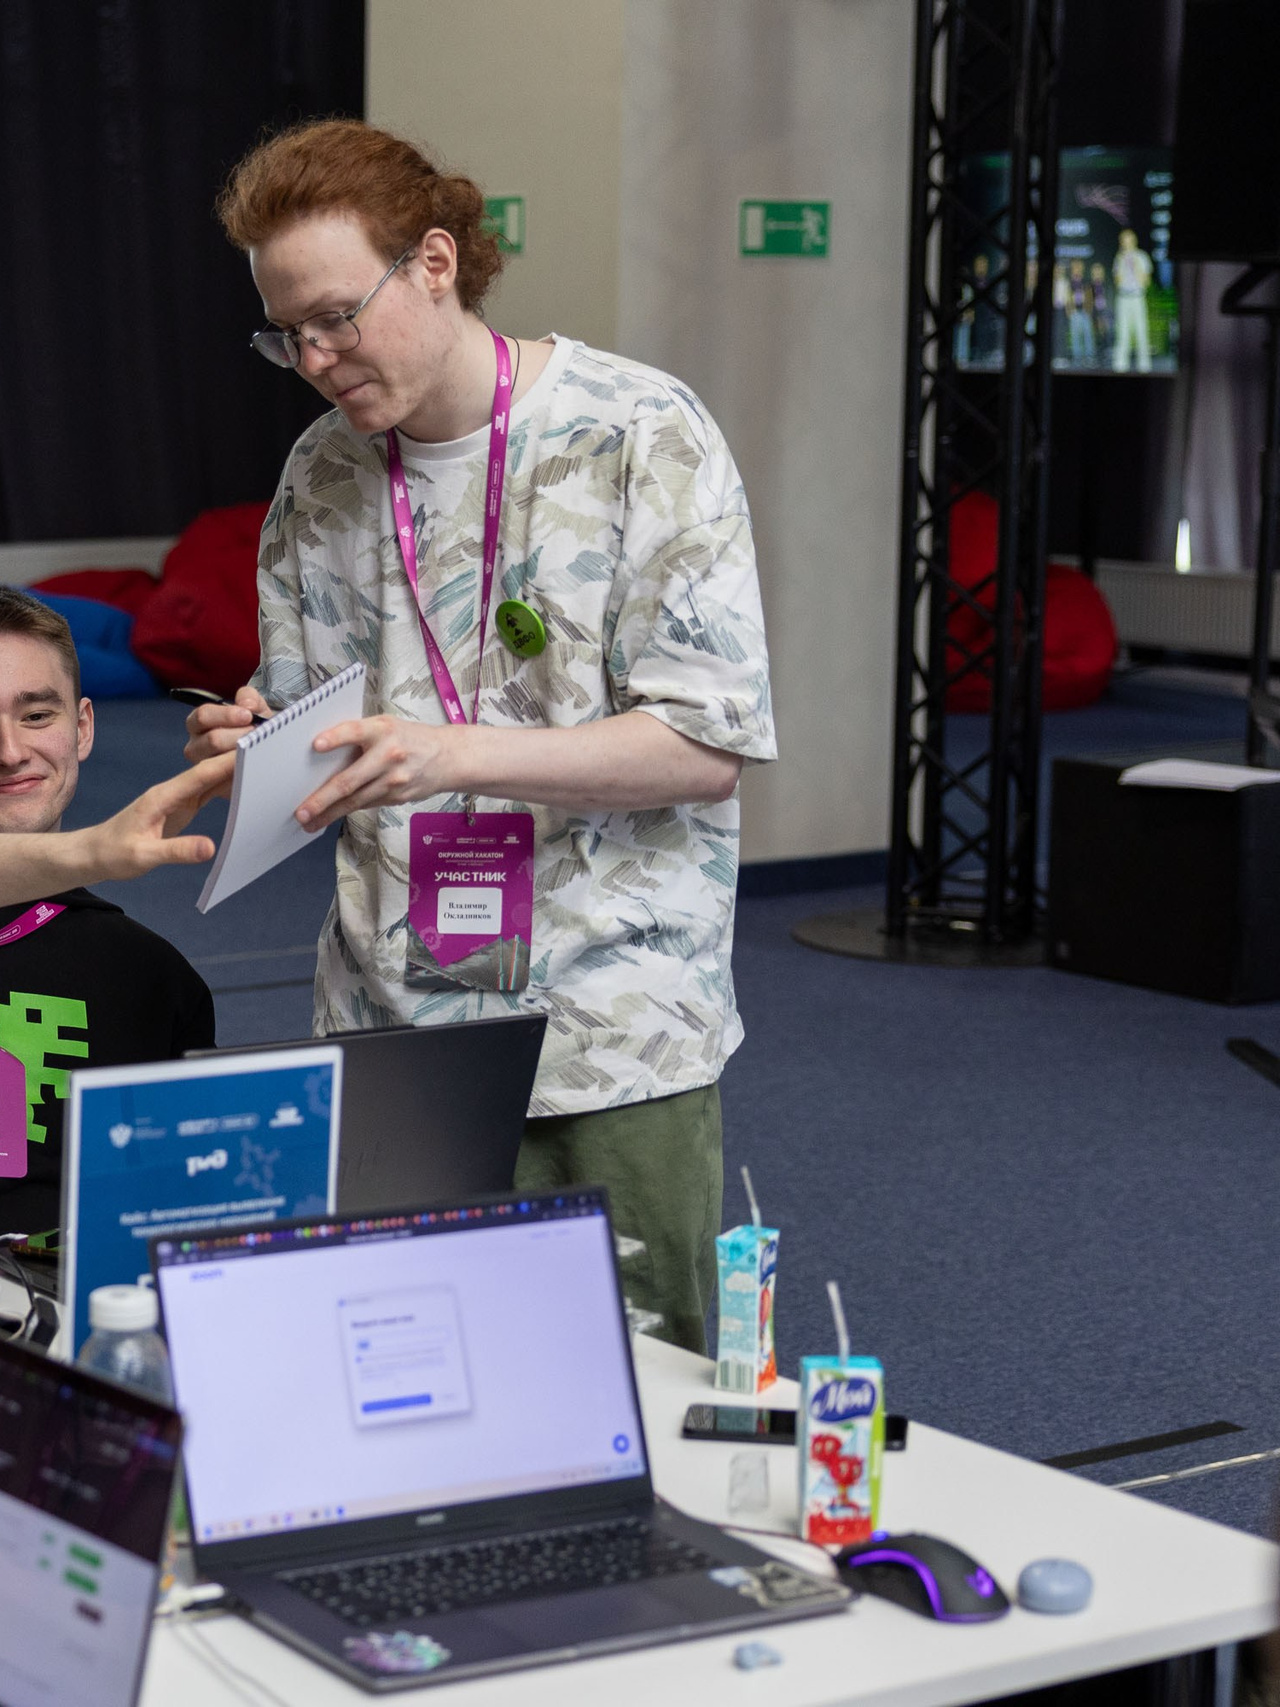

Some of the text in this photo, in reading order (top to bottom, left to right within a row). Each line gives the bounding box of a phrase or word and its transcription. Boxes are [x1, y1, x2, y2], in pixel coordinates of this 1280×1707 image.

[512, 631, 536, 649] ДВФО
[438, 851, 474, 859] ОКРУЖНОЙ
[434, 871, 507, 882] УЧАСТНИК
[448, 902, 488, 911] Владимир
[443, 911, 492, 920] Окладников
